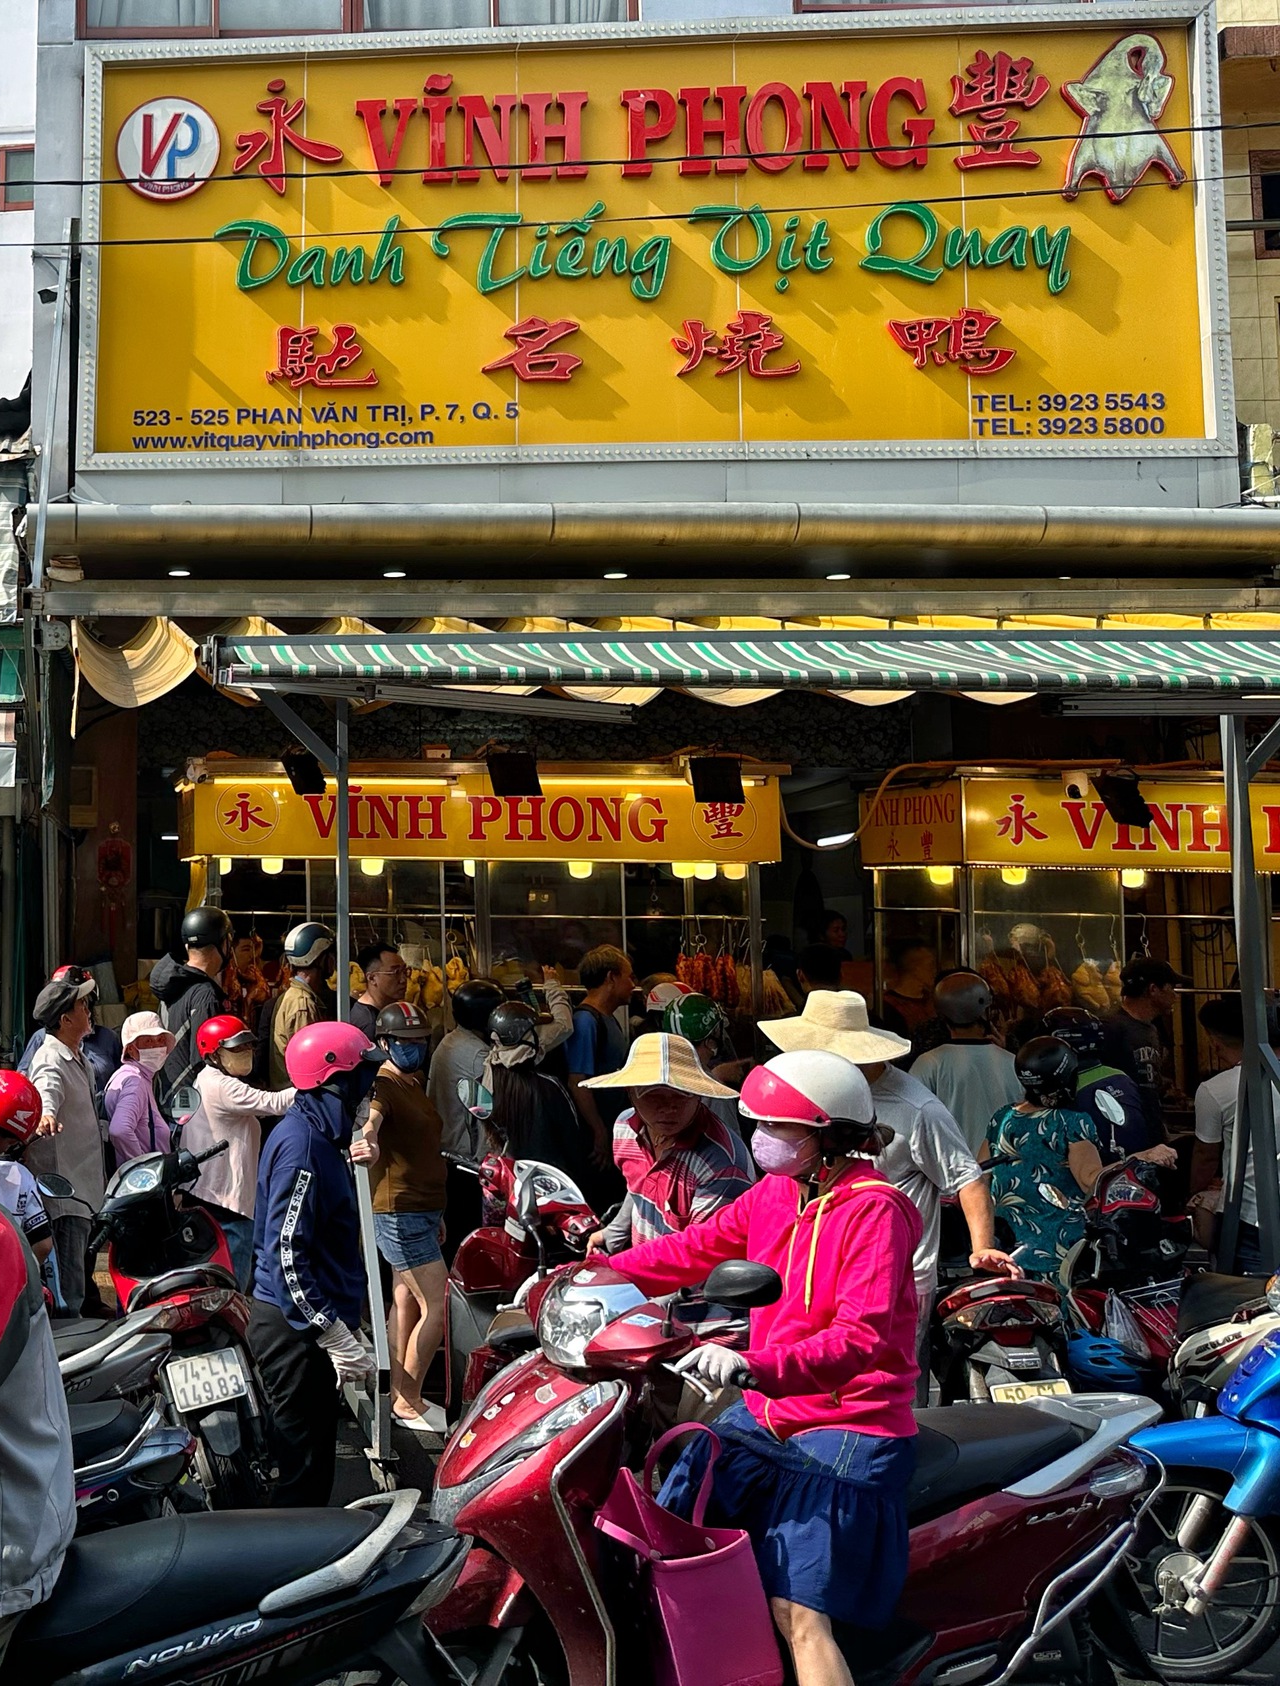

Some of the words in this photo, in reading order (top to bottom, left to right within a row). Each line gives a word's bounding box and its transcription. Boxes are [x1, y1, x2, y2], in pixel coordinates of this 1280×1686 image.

[233, 78, 343, 197] 永
[356, 73, 589, 187] VĨNH
[621, 76, 936, 179] PHONG
[950, 48, 1052, 172] 豐
[142, 112, 200, 180] VP
[214, 214, 406, 292] Danh
[432, 200, 672, 301] Tiếng
[688, 203, 833, 294] Vịt
[859, 202, 1072, 296] Quay
[133, 410, 170, 426] 523
[191, 409, 229, 426] 525
[237, 407, 302, 425] PHAN
[311, 401, 357, 423] VĂN
[367, 405, 413, 427] TRỊ,
[421, 404, 439, 421] P.
[445, 404, 465, 423] 7,
[472, 402, 499, 420] Q.
[505, 402, 519, 419] 5
[972, 394, 1031, 412] TEL:
[1038, 393, 1099, 412] 3923
[1105, 392, 1165, 411] 5543
[132, 430, 434, 451] www.vitquayvinhphong.com
[972, 418, 1031, 436] TEL:
[1038, 417, 1099, 435] 3923
[1104, 416, 1165, 435] 5800
[223, 793, 273, 833] 永
[303, 785, 448, 841] VĨNH
[467, 795, 669, 843] PHONG
[903, 793, 955, 826] PHONG
[995, 793, 1050, 846] 永
[291, 1177, 308, 1209] KORS
[282, 1210, 299, 1237] KORS
[286, 1271, 303, 1299] KORS
[178, 1353, 230, 1385] 74-L1
[179, 1374, 244, 1407] 149.83
[123, 1617, 264, 1680] NOUVO
